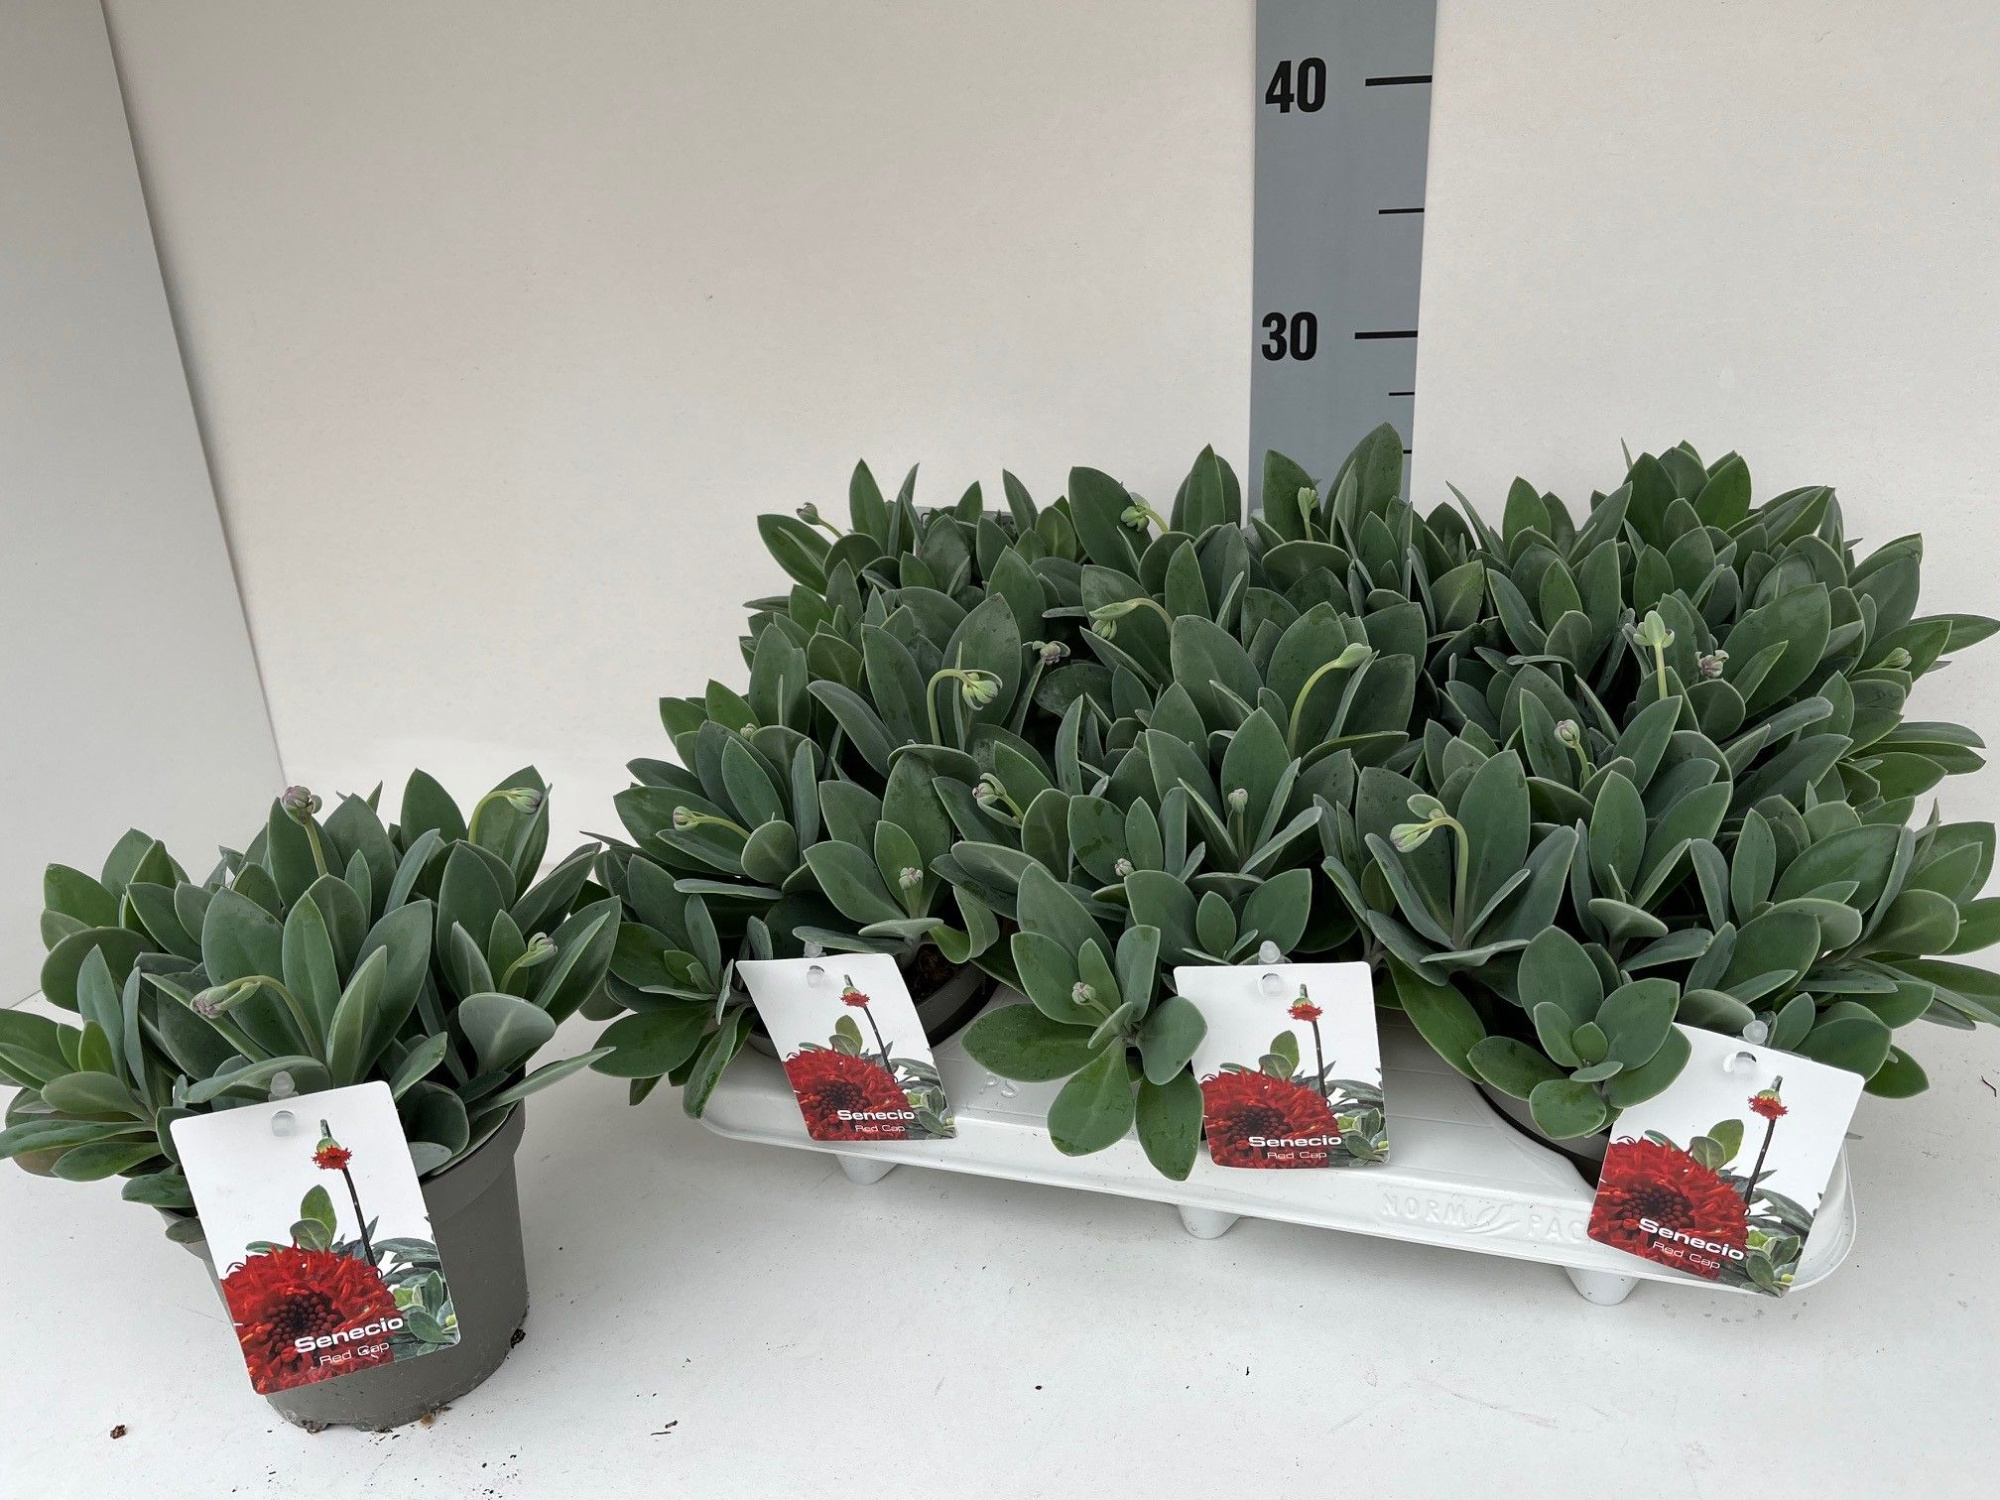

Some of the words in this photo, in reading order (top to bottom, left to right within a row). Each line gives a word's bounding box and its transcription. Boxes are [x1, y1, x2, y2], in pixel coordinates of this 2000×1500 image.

[1264, 57, 1327, 114] 40
[1261, 311, 1318, 362] 30
[836, 1109, 915, 1121] Senecio
[855, 1124, 879, 1133] Red
[882, 1124, 906, 1134] Cap
[1248, 1135, 1342, 1148] Senecio
[1266, 1151, 1295, 1160] Red
[1299, 1151, 1328, 1161] Cap
[1381, 1194, 1467, 1227] NORM
[1527, 1213, 1584, 1244] PAC
[1638, 1217, 1745, 1261] Senecio
[1652, 1241, 1685, 1258] Red
[1688, 1252, 1721, 1270] Cap
[294, 1316, 404, 1354] Senecio
[319, 1350, 352, 1367] Red
